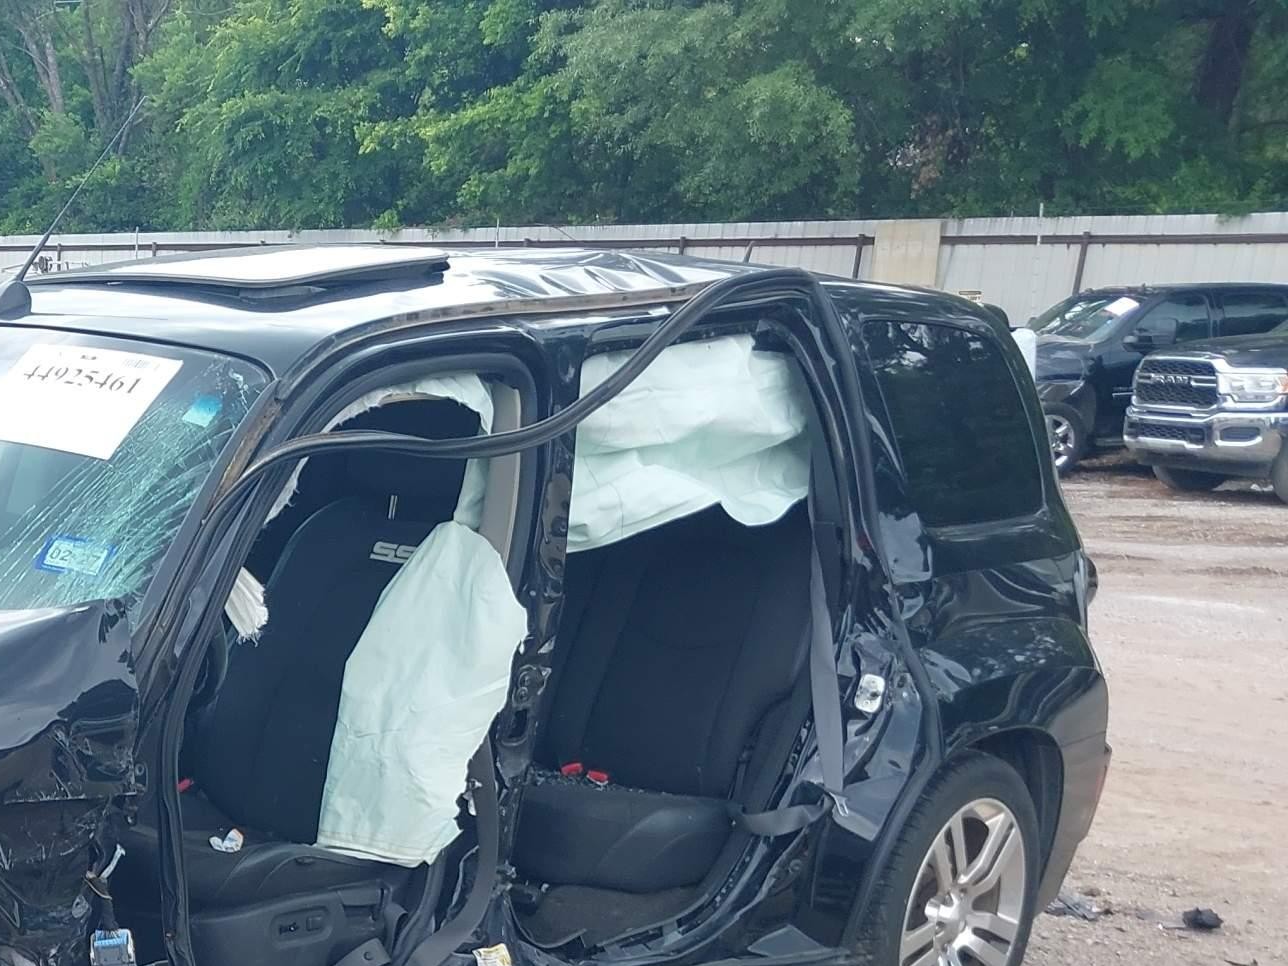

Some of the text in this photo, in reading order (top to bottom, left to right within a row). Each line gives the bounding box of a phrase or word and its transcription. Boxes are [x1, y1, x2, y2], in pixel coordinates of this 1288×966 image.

[23, 364, 142, 394] 44925461
[1152, 373, 1190, 385] RAM
[48, 547, 73, 562] 02
[369, 540, 418, 565] SS
